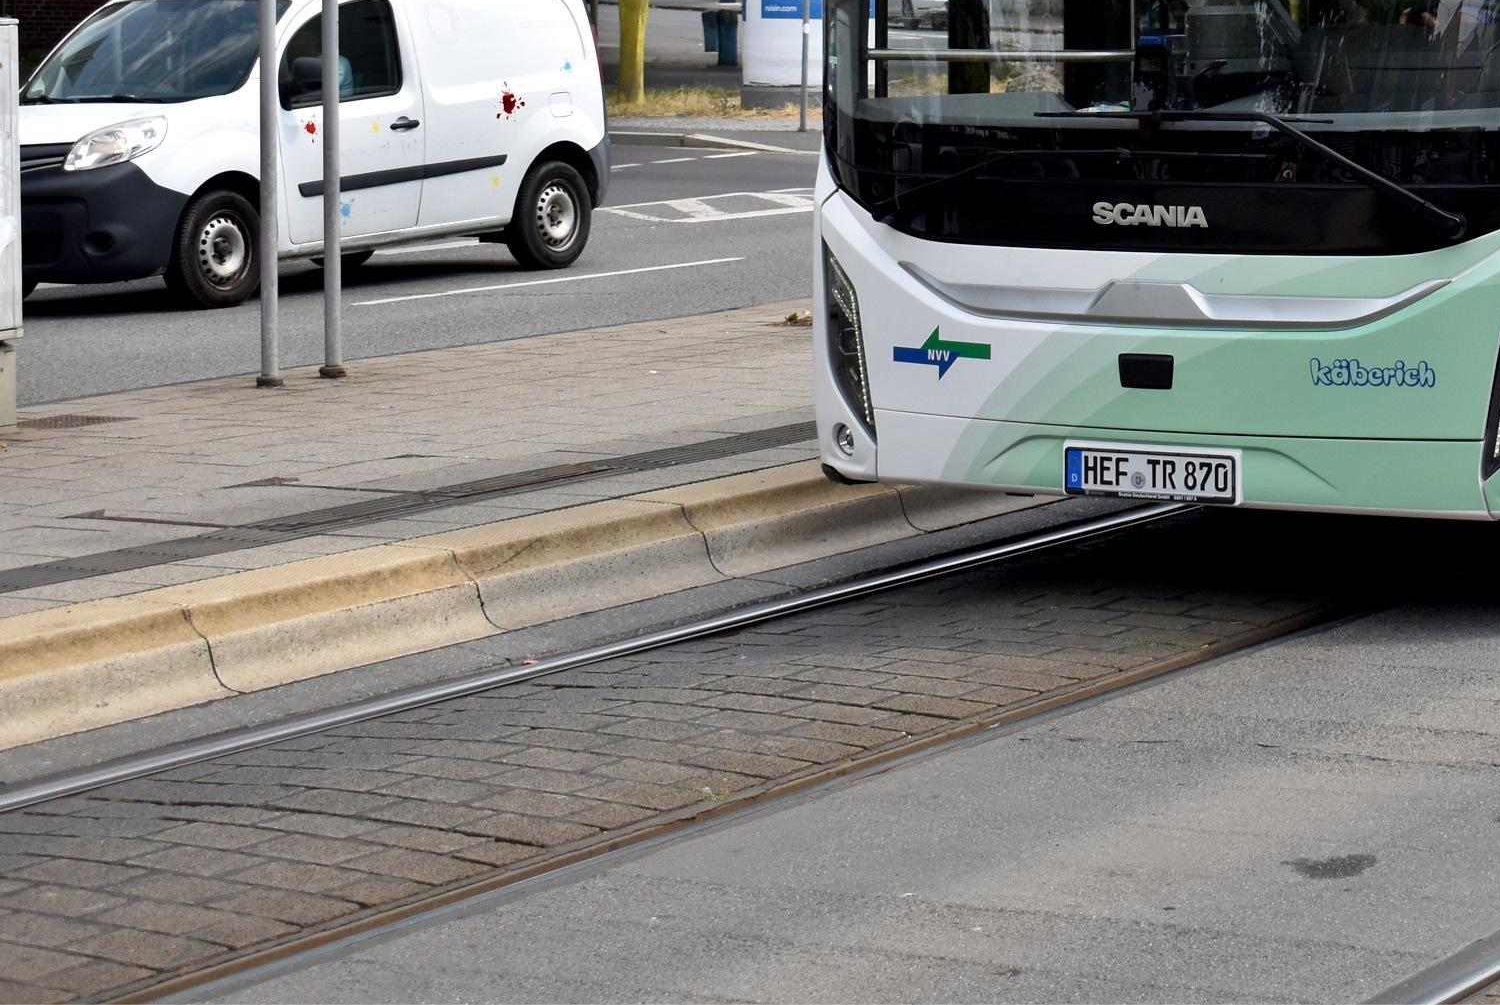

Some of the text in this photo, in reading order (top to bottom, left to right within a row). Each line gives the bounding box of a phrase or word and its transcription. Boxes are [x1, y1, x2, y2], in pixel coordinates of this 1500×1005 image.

[1092, 201, 1209, 228] SCANIA
[927, 348, 951, 362] NVV
[1310, 357, 1436, 388] käberich
[1071, 455, 1229, 493] D HEF TR 870
